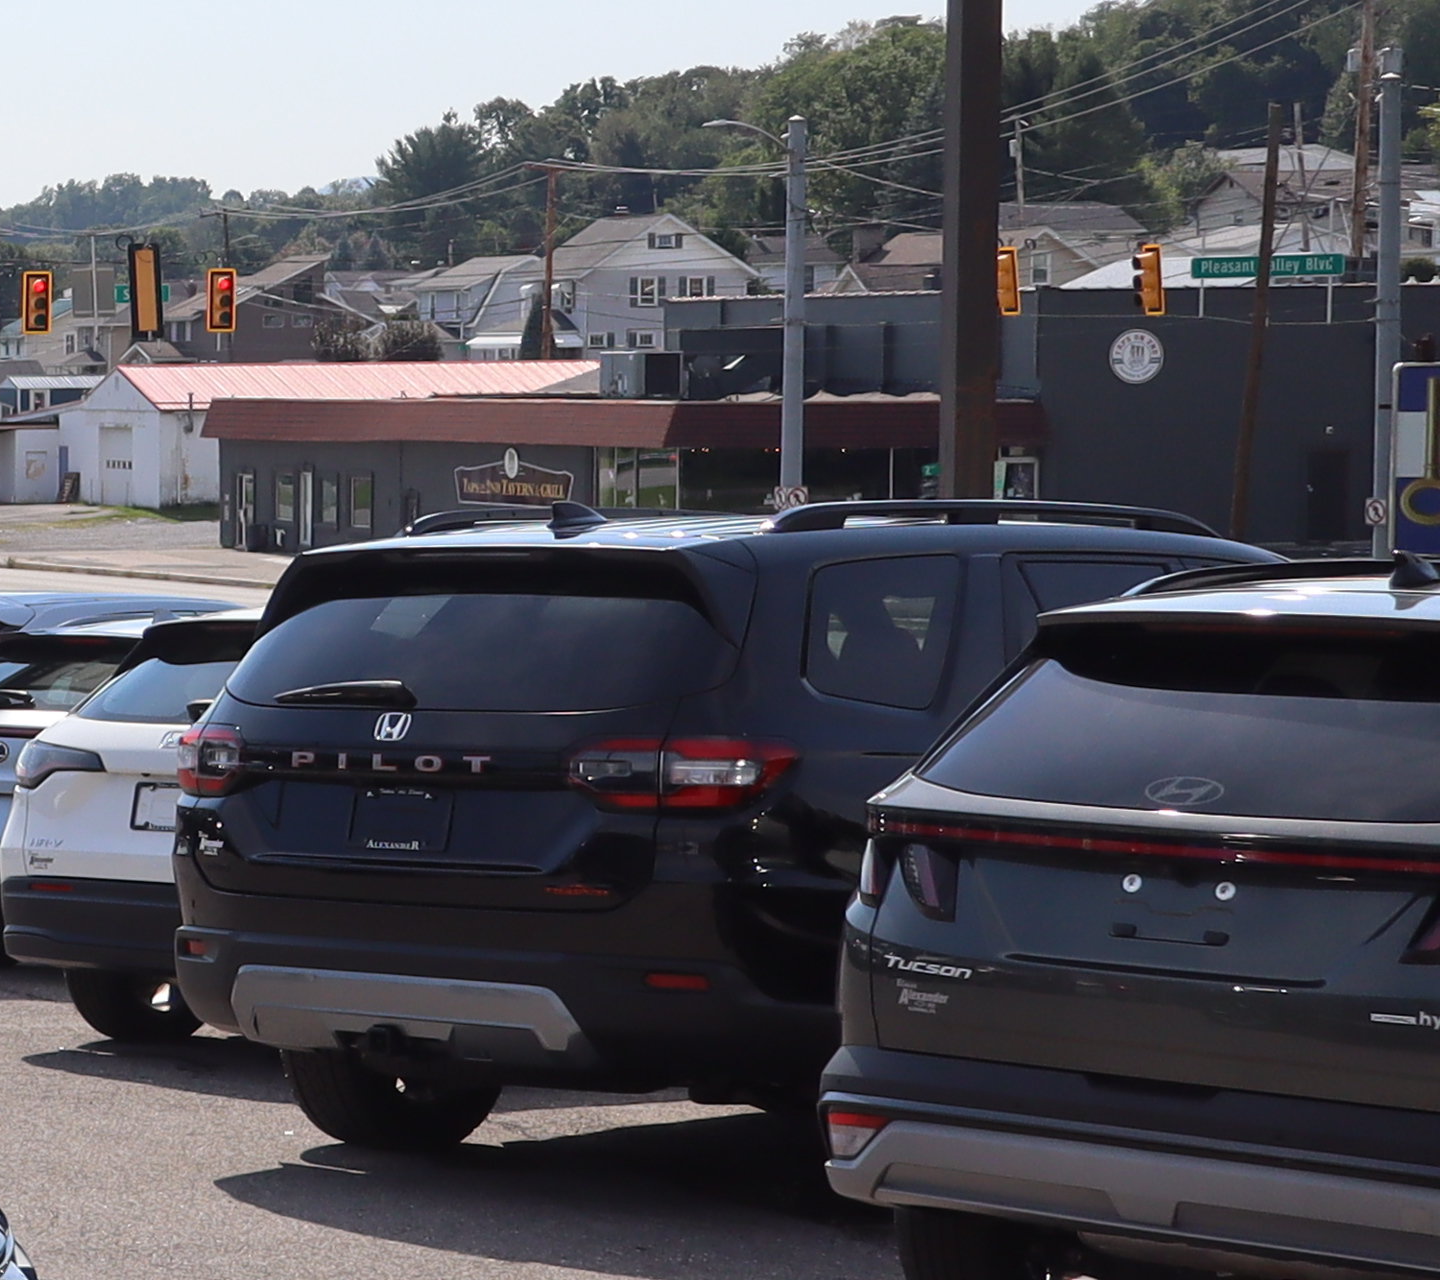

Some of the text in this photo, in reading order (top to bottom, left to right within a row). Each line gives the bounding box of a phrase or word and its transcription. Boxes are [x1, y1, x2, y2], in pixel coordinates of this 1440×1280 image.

[1200, 256, 1333, 275] Pleasant alley Blvd
[540, 484, 565, 499] GRILL
[291, 751, 491, 773] PILOT
